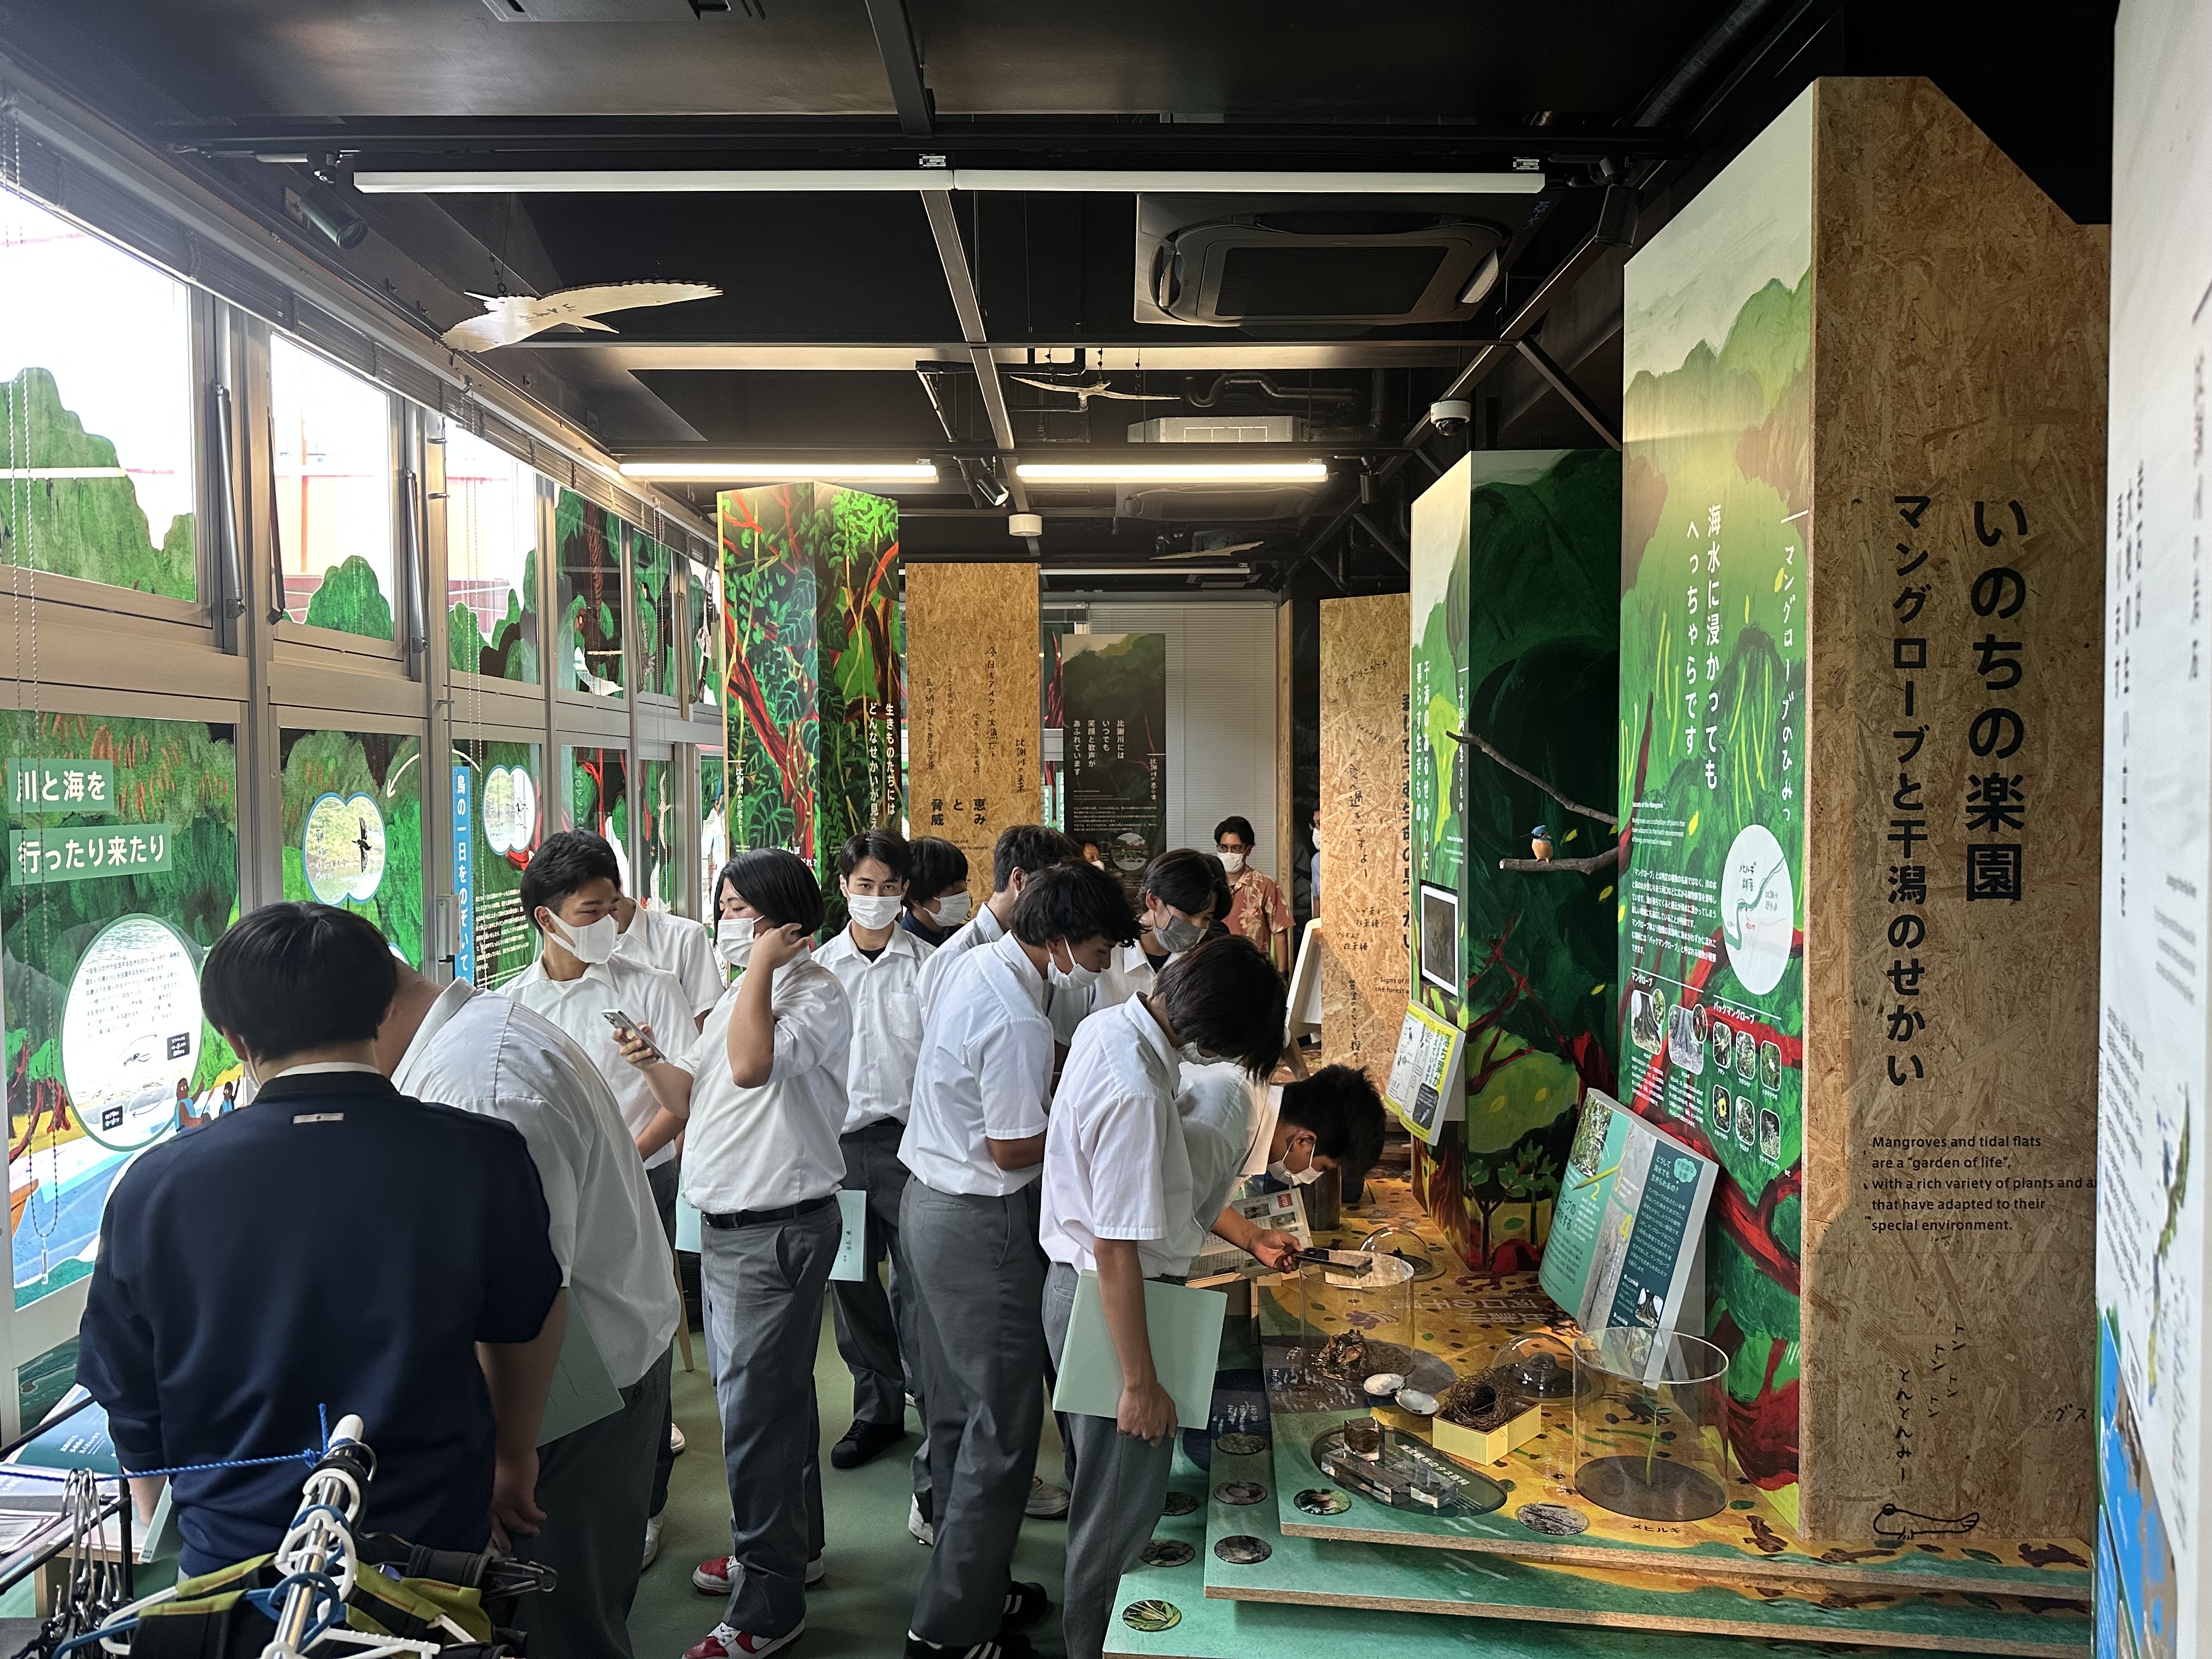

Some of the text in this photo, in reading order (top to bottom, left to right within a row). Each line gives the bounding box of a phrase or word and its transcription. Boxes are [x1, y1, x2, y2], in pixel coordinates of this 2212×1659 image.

[1685, 521, 1700, 756] へっちゃらです
[1705, 504, 1722, 790] 海水に浸かっても
[1781, 545, 1797, 822] マングローブのひみつ
[1966, 499, 2028, 904] いのちの楽園
[1073, 720, 1081, 776] あふれています
[1087, 719, 1096, 768] 笑顔と歓声が
[1102, 720, 1110, 752] いつでも
[1116, 719, 1125, 760] 比謝川には
[885, 703, 895, 816] 生きものたちには
[1015, 738, 1026, 793] 比謝川の未来
[16, 769, 105, 802] 川と海を
[1886, 495, 1931, 1087] マングローブと干潟のせかい
[930, 798, 944, 826] 脅威
[953, 798, 964, 811] と
[973, 798, 986, 825] 恵み
[18, 834, 164, 873] 行ったり来たり
[457, 774, 469, 984] 鳥の一日をのぞいて
[1380, 977, 1397, 985] Signs
[1632, 972, 1653, 987] マングローブ
[1713, 1001, 1756, 1025] バックマングローブ
[1433, 1033, 1453, 1087] 落ち葉が
[1872, 1136, 2041, 1150] Mangroves and tidal flats
[1656, 1154, 1672, 1168] どうして
[1872, 1159, 1893, 1169] are
[1896, 1160, 1904, 1169] a
[1963, 1157, 1979, 1169] of
[1590, 1182, 1600, 1201] 2
[1614, 1169, 1624, 1193] 3
[1872, 1178, 1902, 1190] with
[1906, 1181, 1914, 1190] a
[1917, 1178, 1942, 1190] rich
[1945, 1178, 1992, 1193] variety
[1995, 1178, 2011, 1190] of
[2013, 1178, 2054, 1192] plants
[2057, 1177, 2083, 1189] and
[1871, 1198, 2046, 1212] that have adapted to their
[1619, 1214, 1633, 1243] 4
[1871, 1220, 2013, 1234] special environment.
[1895, 1368, 1914, 1483] とんとんみー
[1631, 1524, 1681, 1534] メヒルギ
